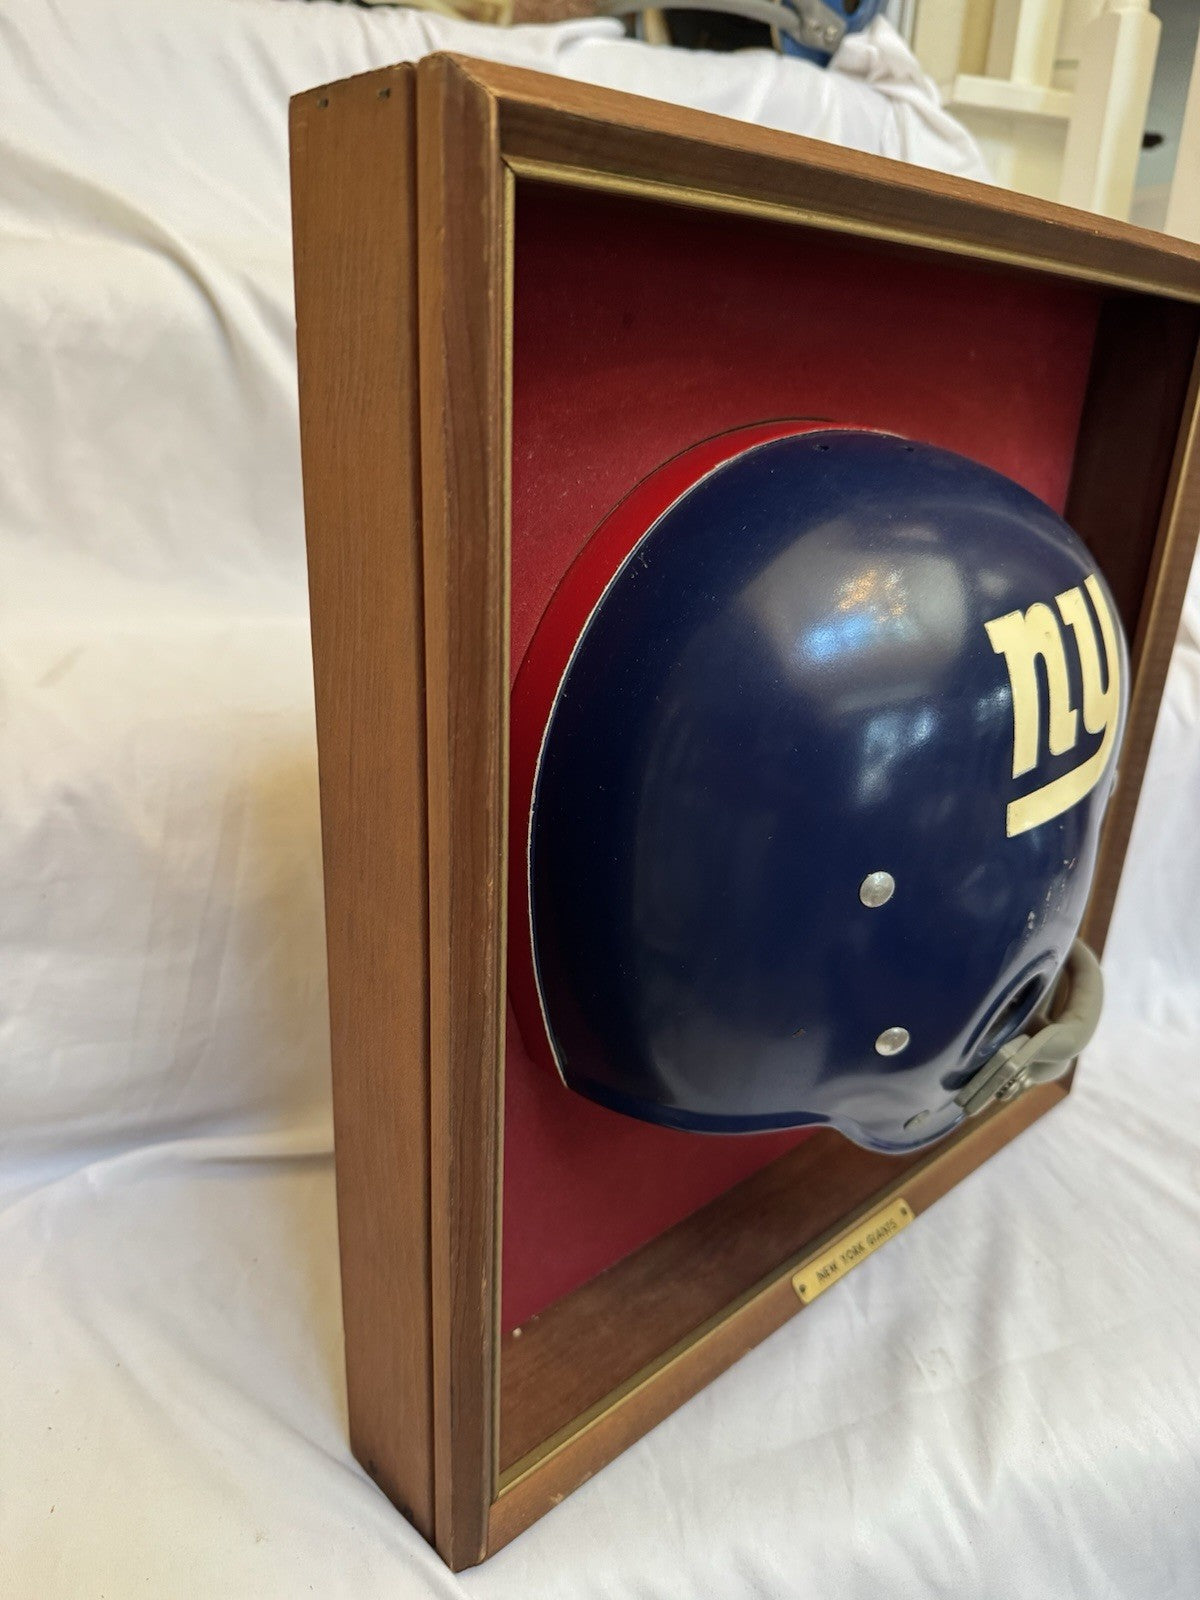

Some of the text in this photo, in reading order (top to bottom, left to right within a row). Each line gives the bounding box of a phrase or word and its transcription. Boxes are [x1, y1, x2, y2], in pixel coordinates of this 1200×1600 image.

[984, 573, 1120, 838] ny
[816, 1218, 898, 1283] NEW YORK GIANTS
